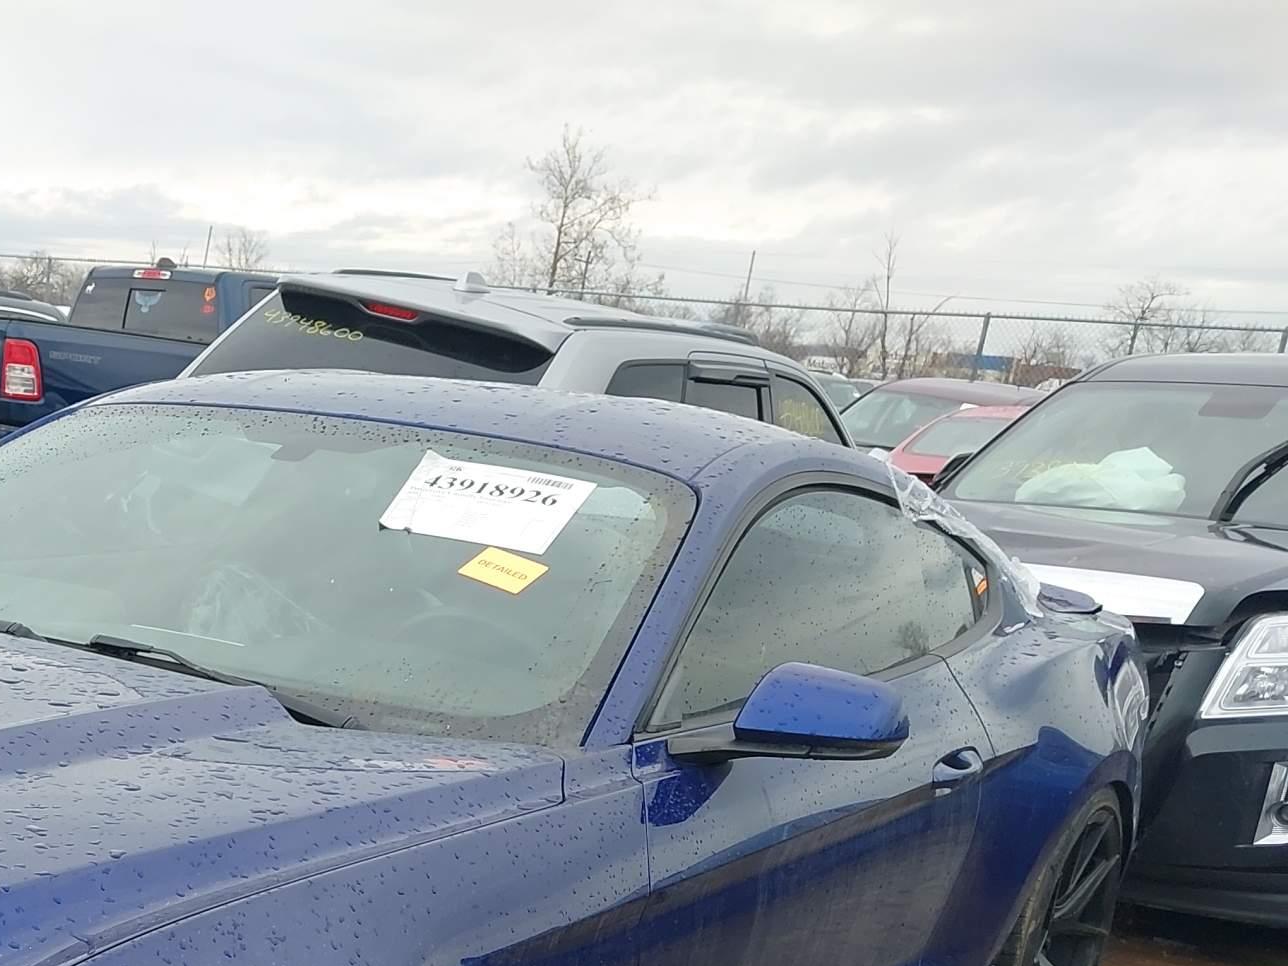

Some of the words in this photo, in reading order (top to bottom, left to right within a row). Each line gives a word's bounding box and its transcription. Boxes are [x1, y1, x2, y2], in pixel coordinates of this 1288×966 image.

[264, 308, 364, 341] 43948600
[424, 474, 560, 507] 43918926
[478, 559, 528, 581] DETAILED
